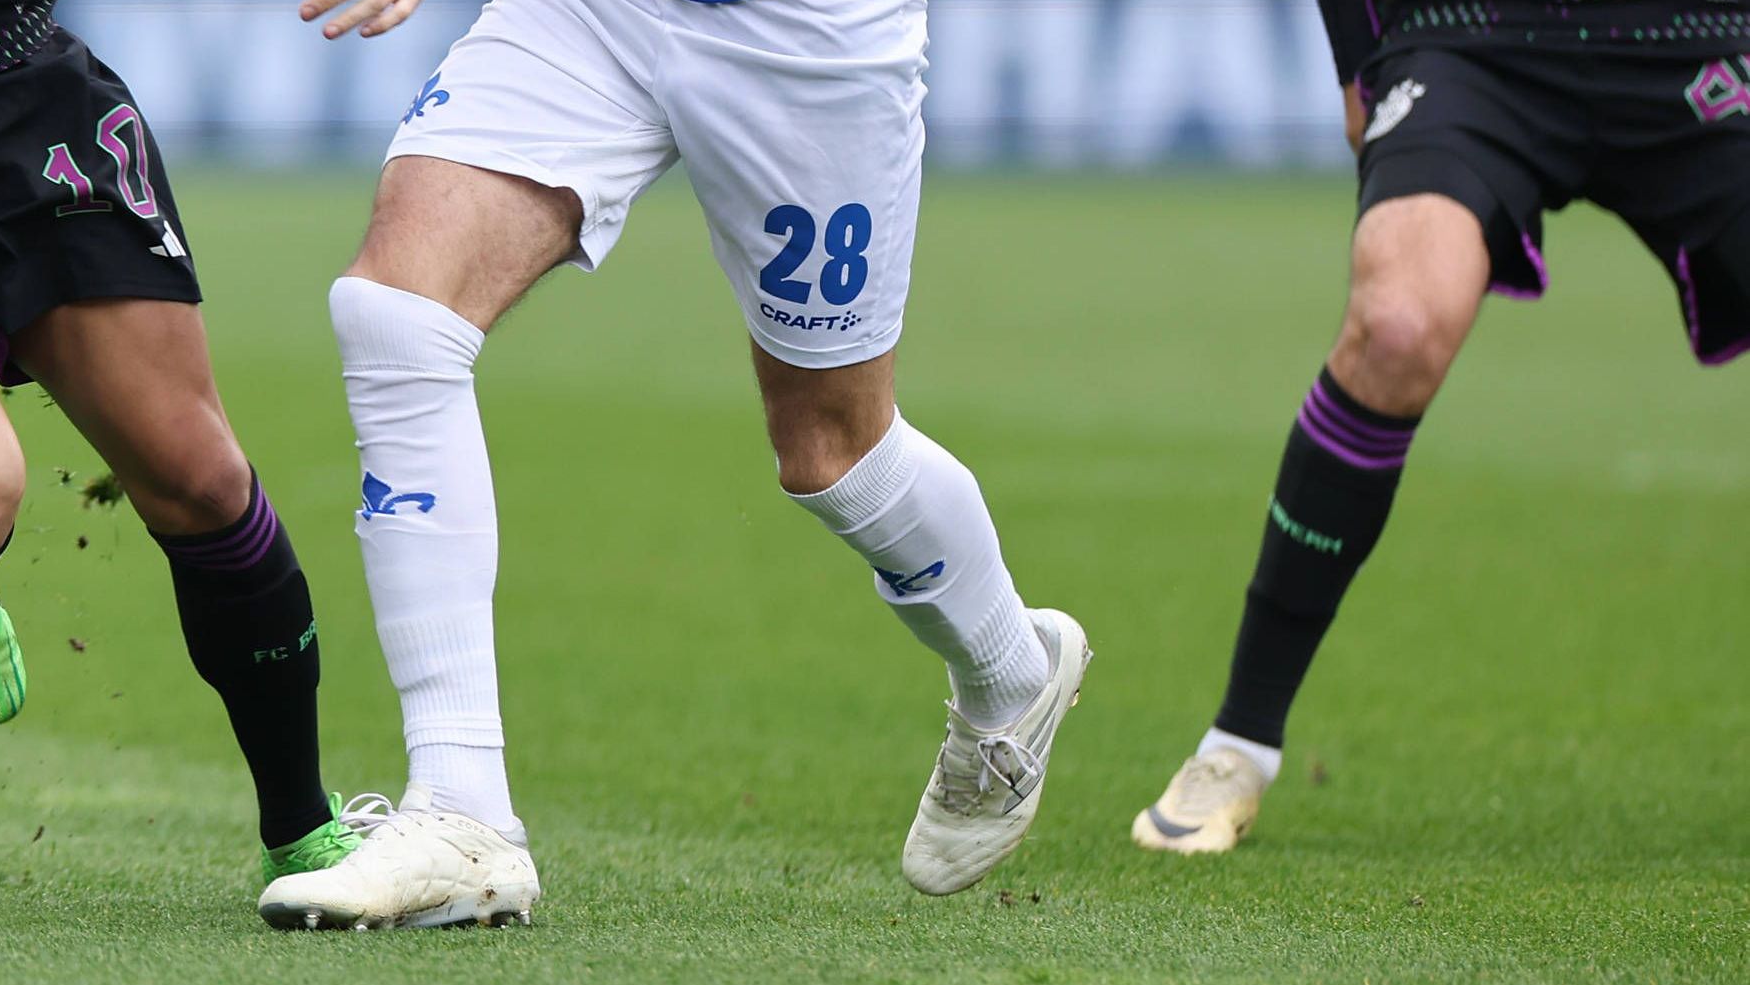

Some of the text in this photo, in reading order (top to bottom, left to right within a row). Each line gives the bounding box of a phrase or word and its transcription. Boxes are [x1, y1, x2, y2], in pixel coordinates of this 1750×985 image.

[42, 103, 159, 219] 10
[760, 203, 872, 305] 28
[760, 303, 841, 331] CRAFT
[254, 646, 289, 663] FC
